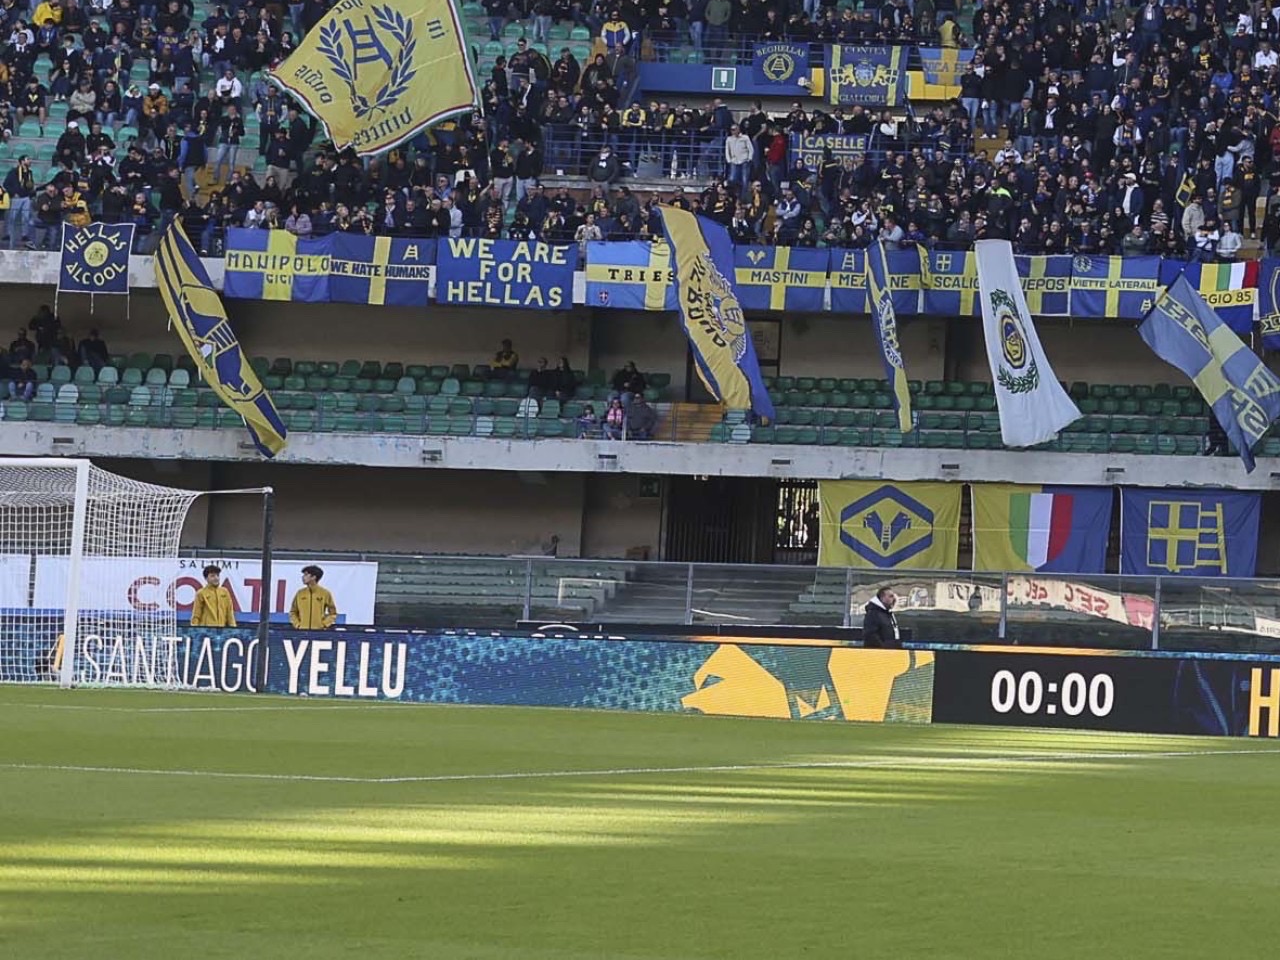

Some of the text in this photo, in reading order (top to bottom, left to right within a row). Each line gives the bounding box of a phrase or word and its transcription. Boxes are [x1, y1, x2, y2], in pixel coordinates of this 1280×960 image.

[805, 137, 865, 150] CASELLE
[65, 225, 127, 253] HELLAS
[448, 238, 569, 264] WE ARE
[66, 262, 126, 286] ALCOOL
[330, 260, 430, 279] WE HATE HUMANS
[479, 261, 532, 284] FOR
[750, 271, 808, 285] MASTINI
[448, 281, 562, 307] HELLAS
[1073, 280, 1155, 290] VIETTE LATERALI
[1236, 291, 1251, 304] 85
[81, 634, 406, 698] SANTIAGO YELLU
[990, 670, 1114, 717] 00:00
